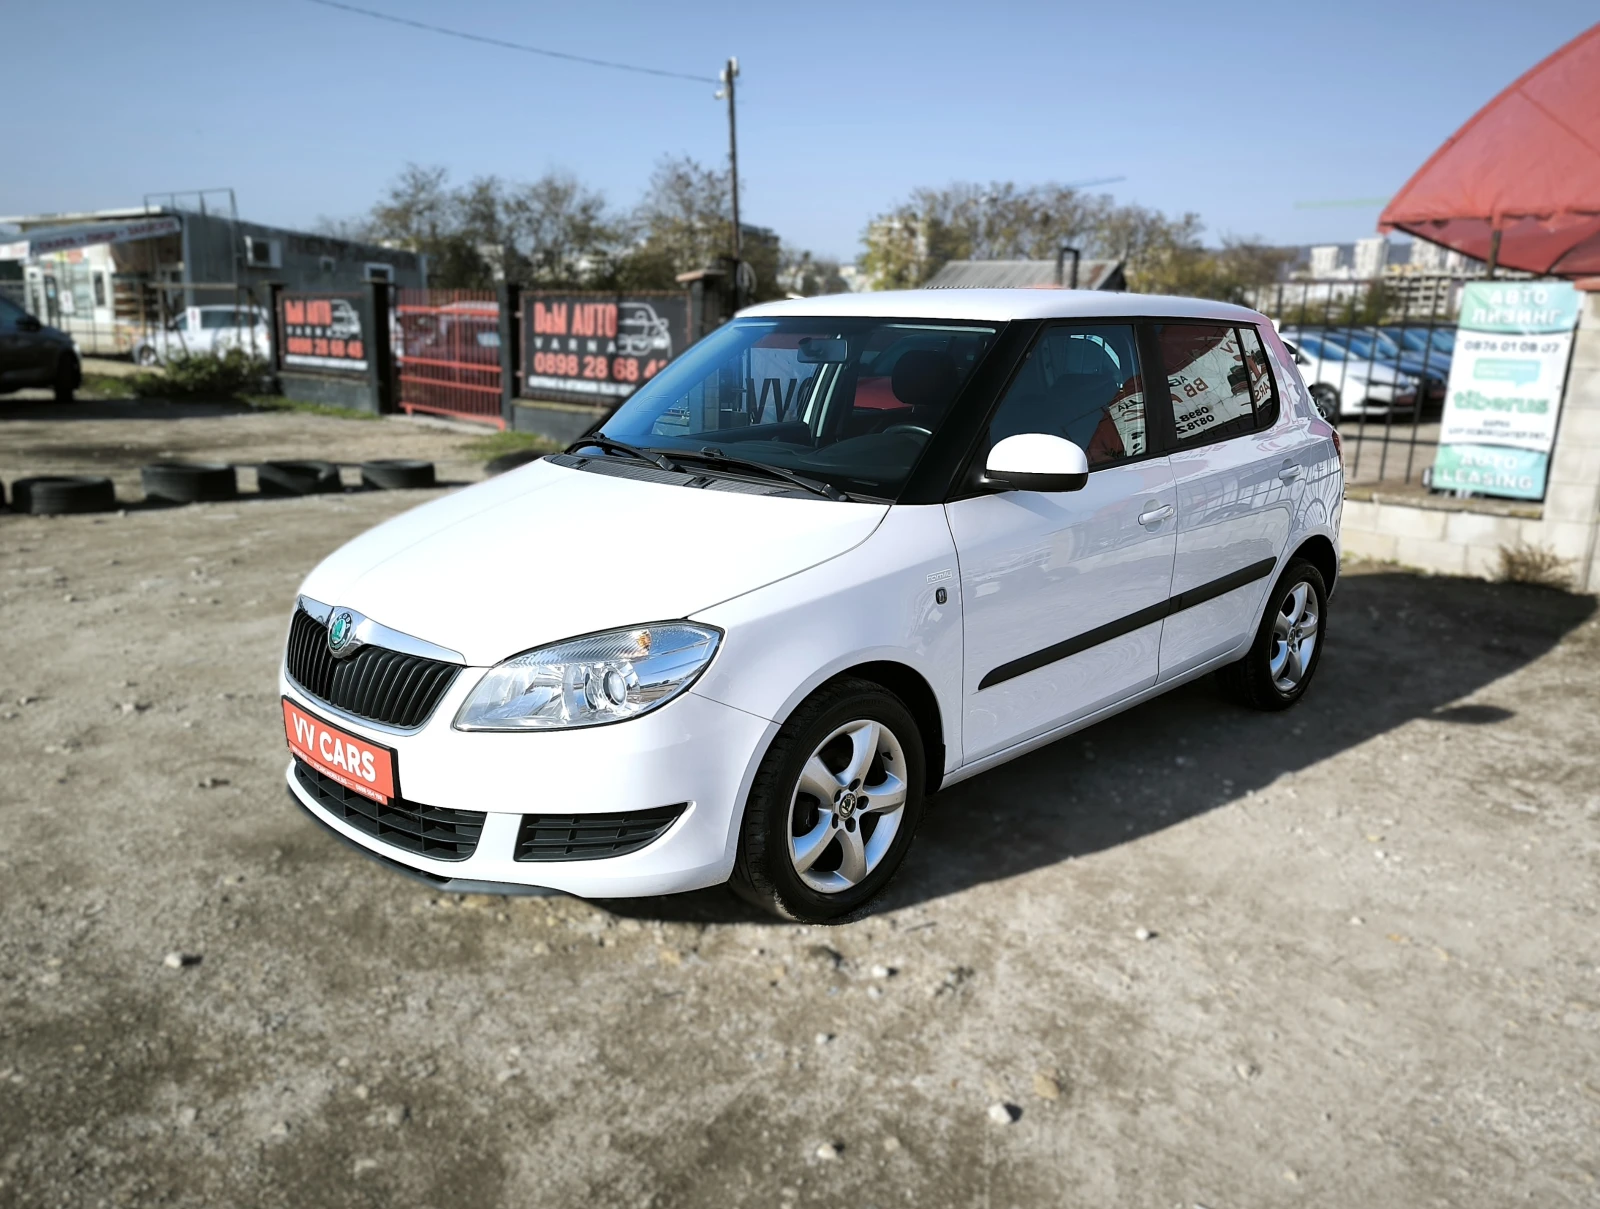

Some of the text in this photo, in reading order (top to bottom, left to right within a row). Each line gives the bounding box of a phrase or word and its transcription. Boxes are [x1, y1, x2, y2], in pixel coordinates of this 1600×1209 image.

[571, 303, 618, 338] AUTO
[534, 337, 617, 355] VARNA
[1463, 339, 1497, 352] 0876
[1500, 342, 1516, 352] 01
[534, 352, 579, 376] 0898
[582, 355, 609, 380] 28
[612, 357, 639, 382] 68
[1442, 469, 1533, 489] LEASING
[292, 712, 377, 783] VV CARS
